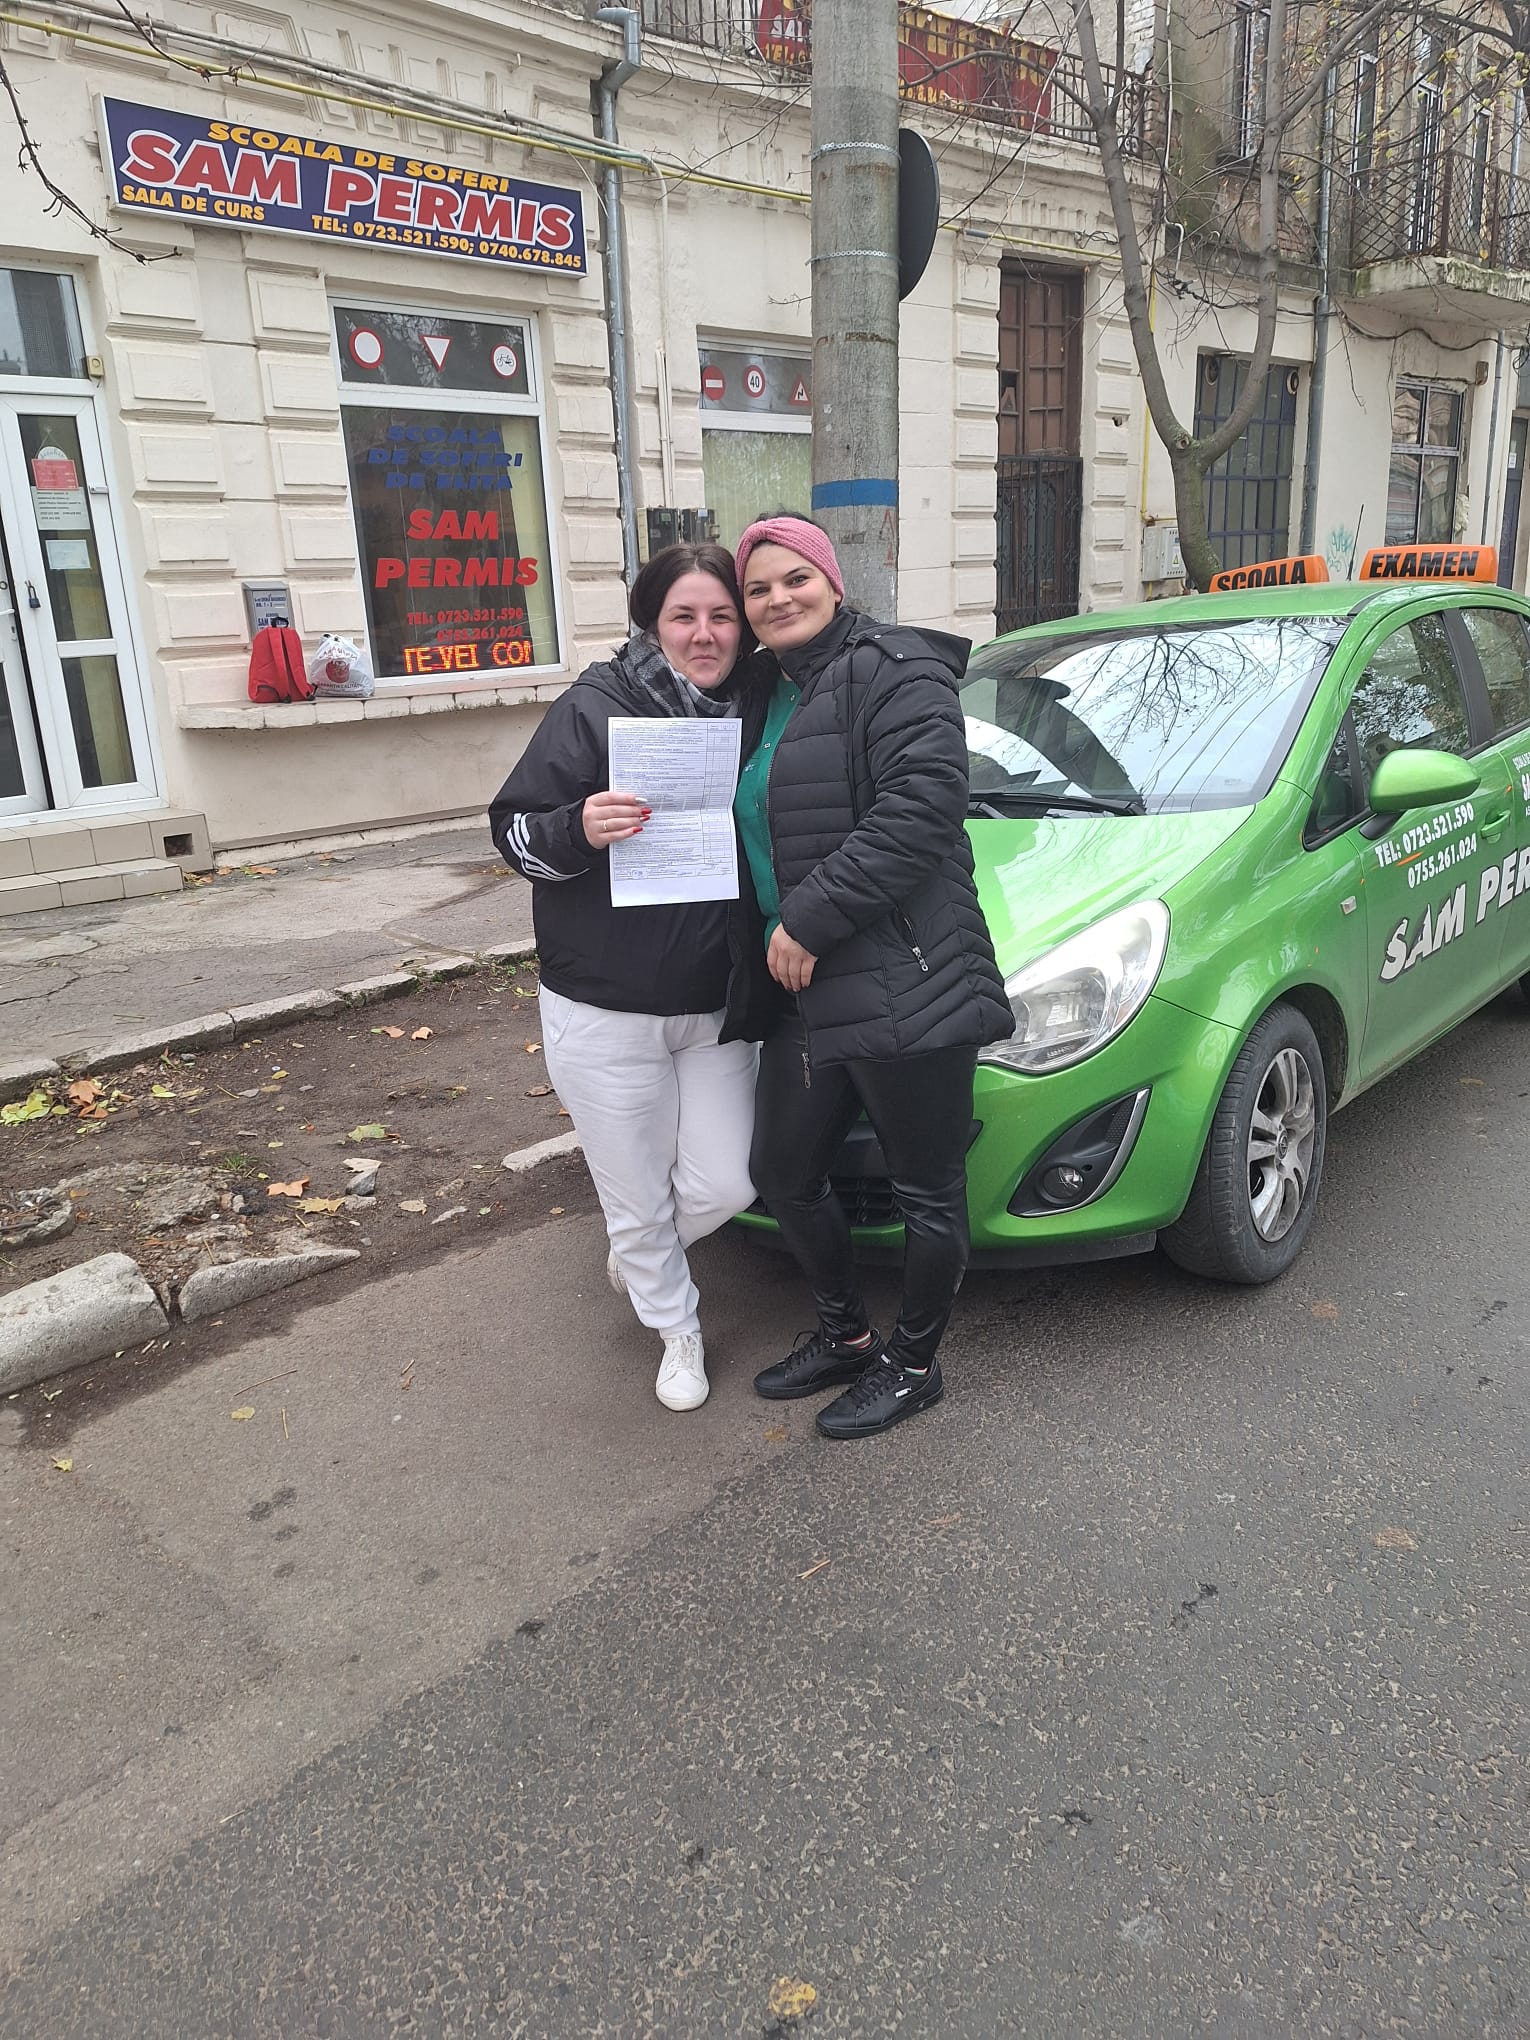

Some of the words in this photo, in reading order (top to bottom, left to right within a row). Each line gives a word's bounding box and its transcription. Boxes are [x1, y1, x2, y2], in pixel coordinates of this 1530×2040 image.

[208, 121, 345, 163] SCOALA
[354, 149, 395, 172] DE
[405, 160, 510, 194] SOFERI
[120, 128, 302, 209] SAM
[323, 164, 575, 250] PERMIS
[121, 184, 178, 207] SALA
[181, 194, 208, 213] DE
[213, 200, 266, 222] CURS
[311, 215, 348, 234] TEL:
[353, 221, 474, 255] 0723.521.590;
[479, 241, 582, 268] 0740.678.845
[750, 375, 760, 388] 40
[386, 424, 501, 443] SCOALA
[367, 447, 409, 464] DE
[419, 450, 523, 467] SOFERI
[385, 471, 426, 489] DE
[436, 472, 513, 489] ELITA
[407, 509, 499, 541] SAM
[375, 557, 539, 589] PERMIS
[1217, 560, 1306, 592] SCOALA
[1370, 551, 1479, 578] EXAMEN
[407, 611, 433, 625] TEL:
[437, 607, 523, 624] 0723.521.590
[1375, 843, 1402, 868] TEL:
[1402, 801, 1474, 855] 0723.521.590
[1407, 832, 1477, 889] 0755.261.024
[1379, 882, 1466, 983] SAM
